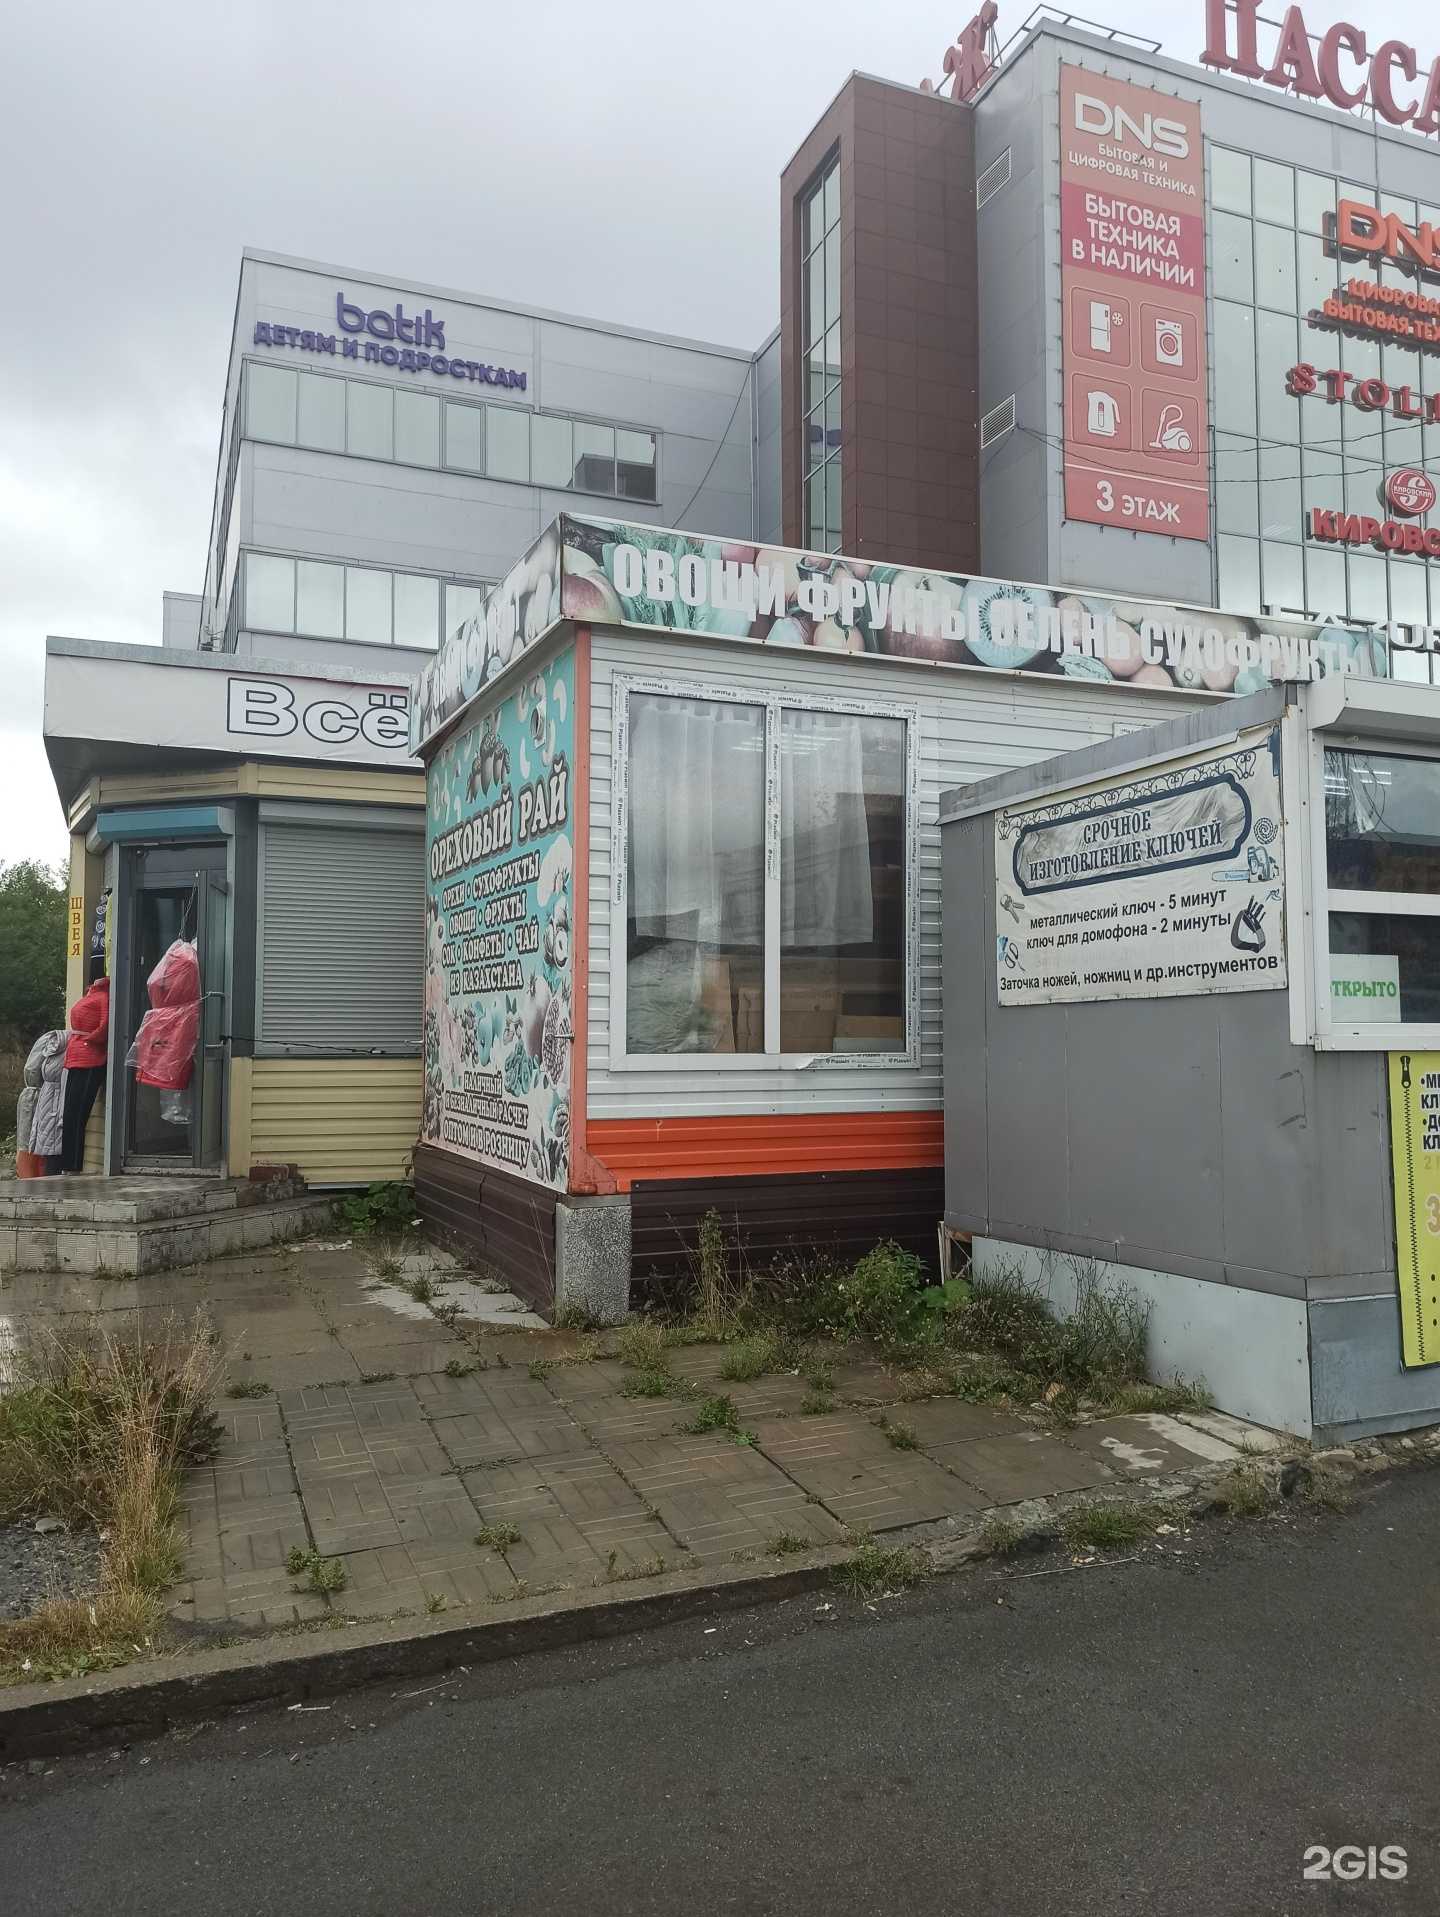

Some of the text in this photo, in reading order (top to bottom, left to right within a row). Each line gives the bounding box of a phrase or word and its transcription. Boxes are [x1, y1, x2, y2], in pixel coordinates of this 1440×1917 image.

[1074, 92, 1189, 159] DNS
[1068, 151, 1197, 197] ЦИФРОВАЯ ТЕХНИКА
[1098, 143, 1169, 173] БЫТОВАЯ И
[1085, 192, 1181, 236] БЫТОВАЯ
[1338, 198, 1440, 271] DN
[1086, 217, 1180, 260] ТЕХНИКА
[1071, 238, 1195, 287] В НАЛИЧИИ
[337, 291, 445, 350] batik
[1323, 298, 1409, 336] БЫТОВАЯ
[254, 320, 527, 391] ДЕТЯМ И ПОДРОСТКАМ
[1096, 480, 1181, 524] 3 ЭТАЖ
[613, 543, 786, 622] ОВОЩИ
[799, 573, 981, 642] ФРУКТЫ
[227, 677, 410, 749] Всё
[430, 757, 567, 880] ОРЕХОВЫЙ РАЙ
[1083, 810, 1151, 845] СРОЧНОЕ
[1029, 819, 1223, 881] ИЗГОТОВЛЕНИЕ КЛЮЧЕЙ
[443, 851, 540, 912] ОРЕХИ СУХОФРУКТЫ
[70, 896, 84, 956] ШВЕЯ
[449, 891, 527, 937] ОВОЩИ ФРУКТЫ
[1026, 936, 1055, 949] ключ
[1057, 932, 1078, 948] для
[1081, 923, 1148, 945] домофона
[1160, 918, 1168, 933] 2
[1172, 912, 1231, 934] минуты
[1030, 903, 1118, 930] металлический
[1122, 900, 1156, 917] ключ
[1168, 895, 1176, 910] 5
[1180, 889, 1227, 909] минут
[442, 917, 539, 967] СОК КОНФЕТЫ ЧАЙ
[449, 961, 524, 995] ИЗ КАЗАХСТАНА
[1000, 977, 1040, 991] Заточка
[1042, 970, 1081, 988] ножей,
[1083, 970, 1131, 985] ножниц
[1134, 969, 1143, 980] и
[1329, 980, 1397, 997] ТКРЫТО
[464, 1071, 503, 1098] НАЛИЧНЫЙ
[450, 1091, 498, 1122] БЕЗНАЛИЧНЫЙ
[498, 1100, 529, 1129] РАСЧЕТ
[443, 1117, 530, 1170] ОПТОМ И В РОЗНИЦУ
